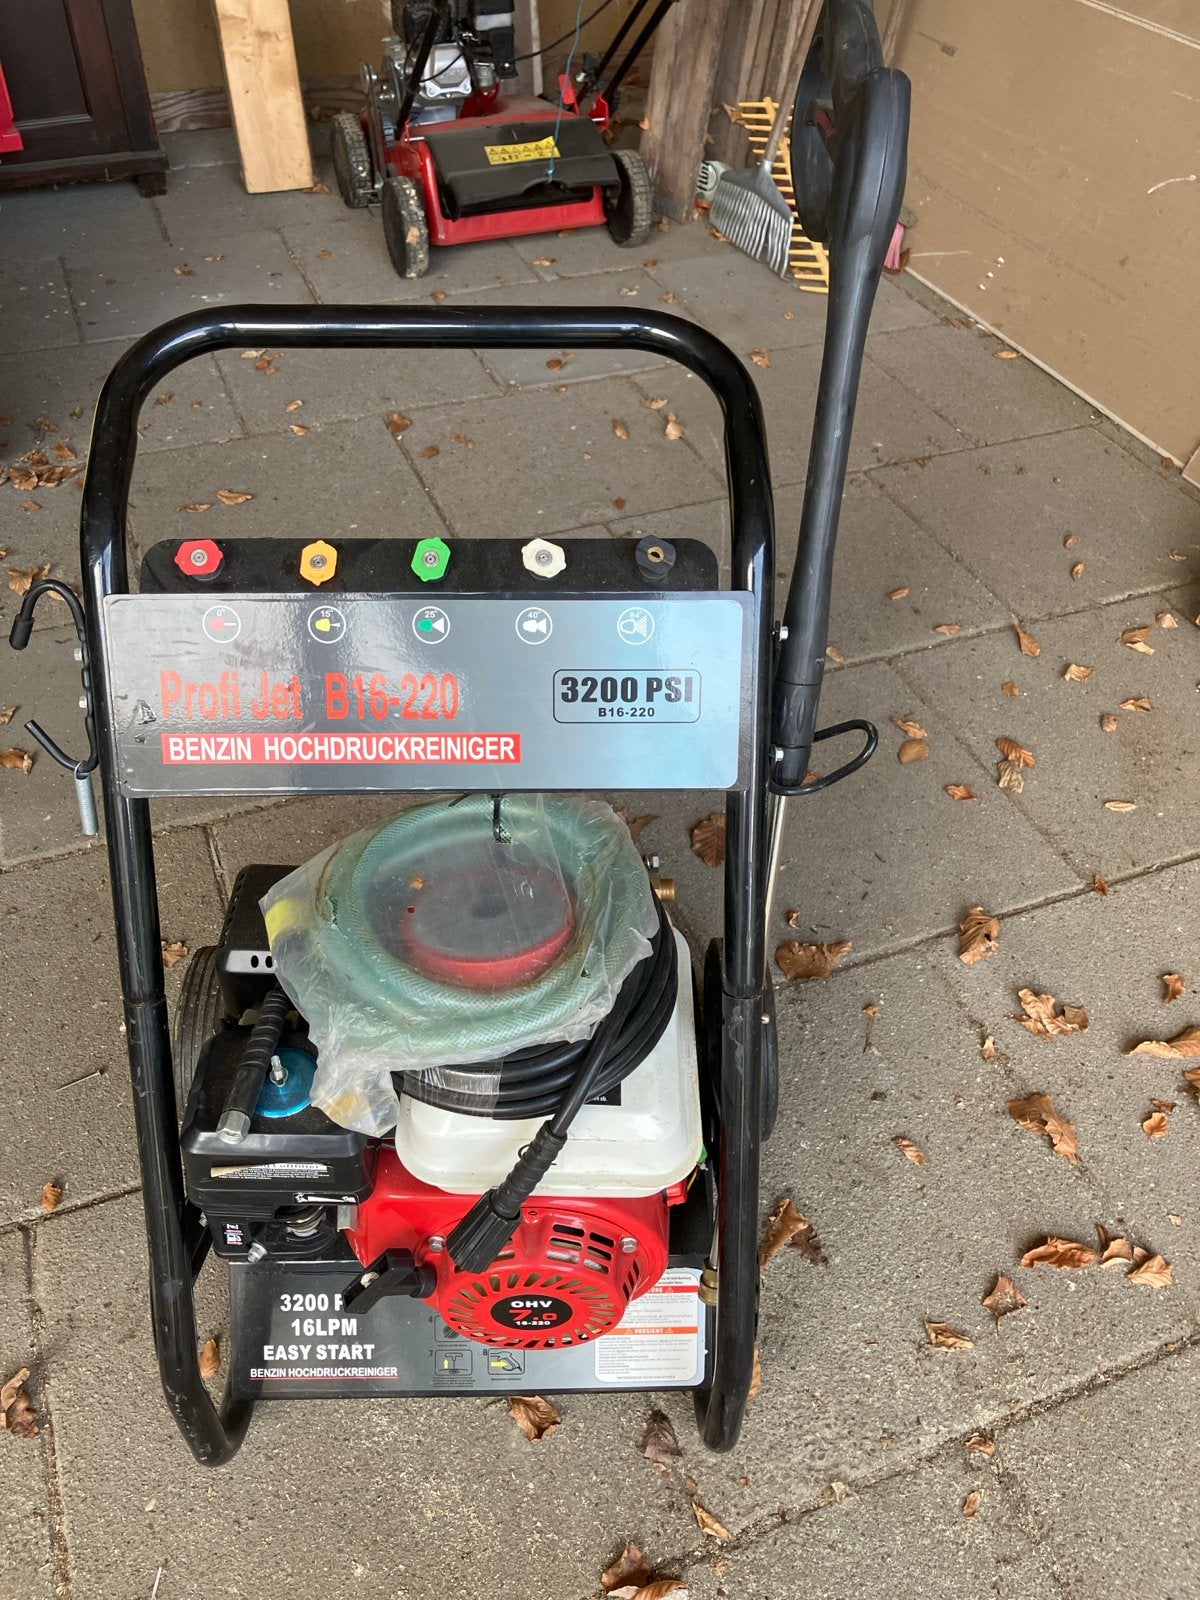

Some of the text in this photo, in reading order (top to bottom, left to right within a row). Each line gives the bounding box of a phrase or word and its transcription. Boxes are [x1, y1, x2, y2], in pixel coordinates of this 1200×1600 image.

[160, 669, 460, 722] Profi Jet B16-220
[560, 676, 694, 703] 3200 PSI
[597, 706, 656, 718] B16-220
[168, 735, 516, 762] BENZIN HOCHDRUCKREINIGER
[280, 1293, 329, 1312] 3200
[510, 1300, 553, 1309] OHV
[508, 1309, 558, 1321] 7.0
[291, 1318, 358, 1336] 16LPM
[263, 1344, 376, 1361] EASY START
[250, 1366, 398, 1378] BENZIN HOCHDRUCKREINIGER
